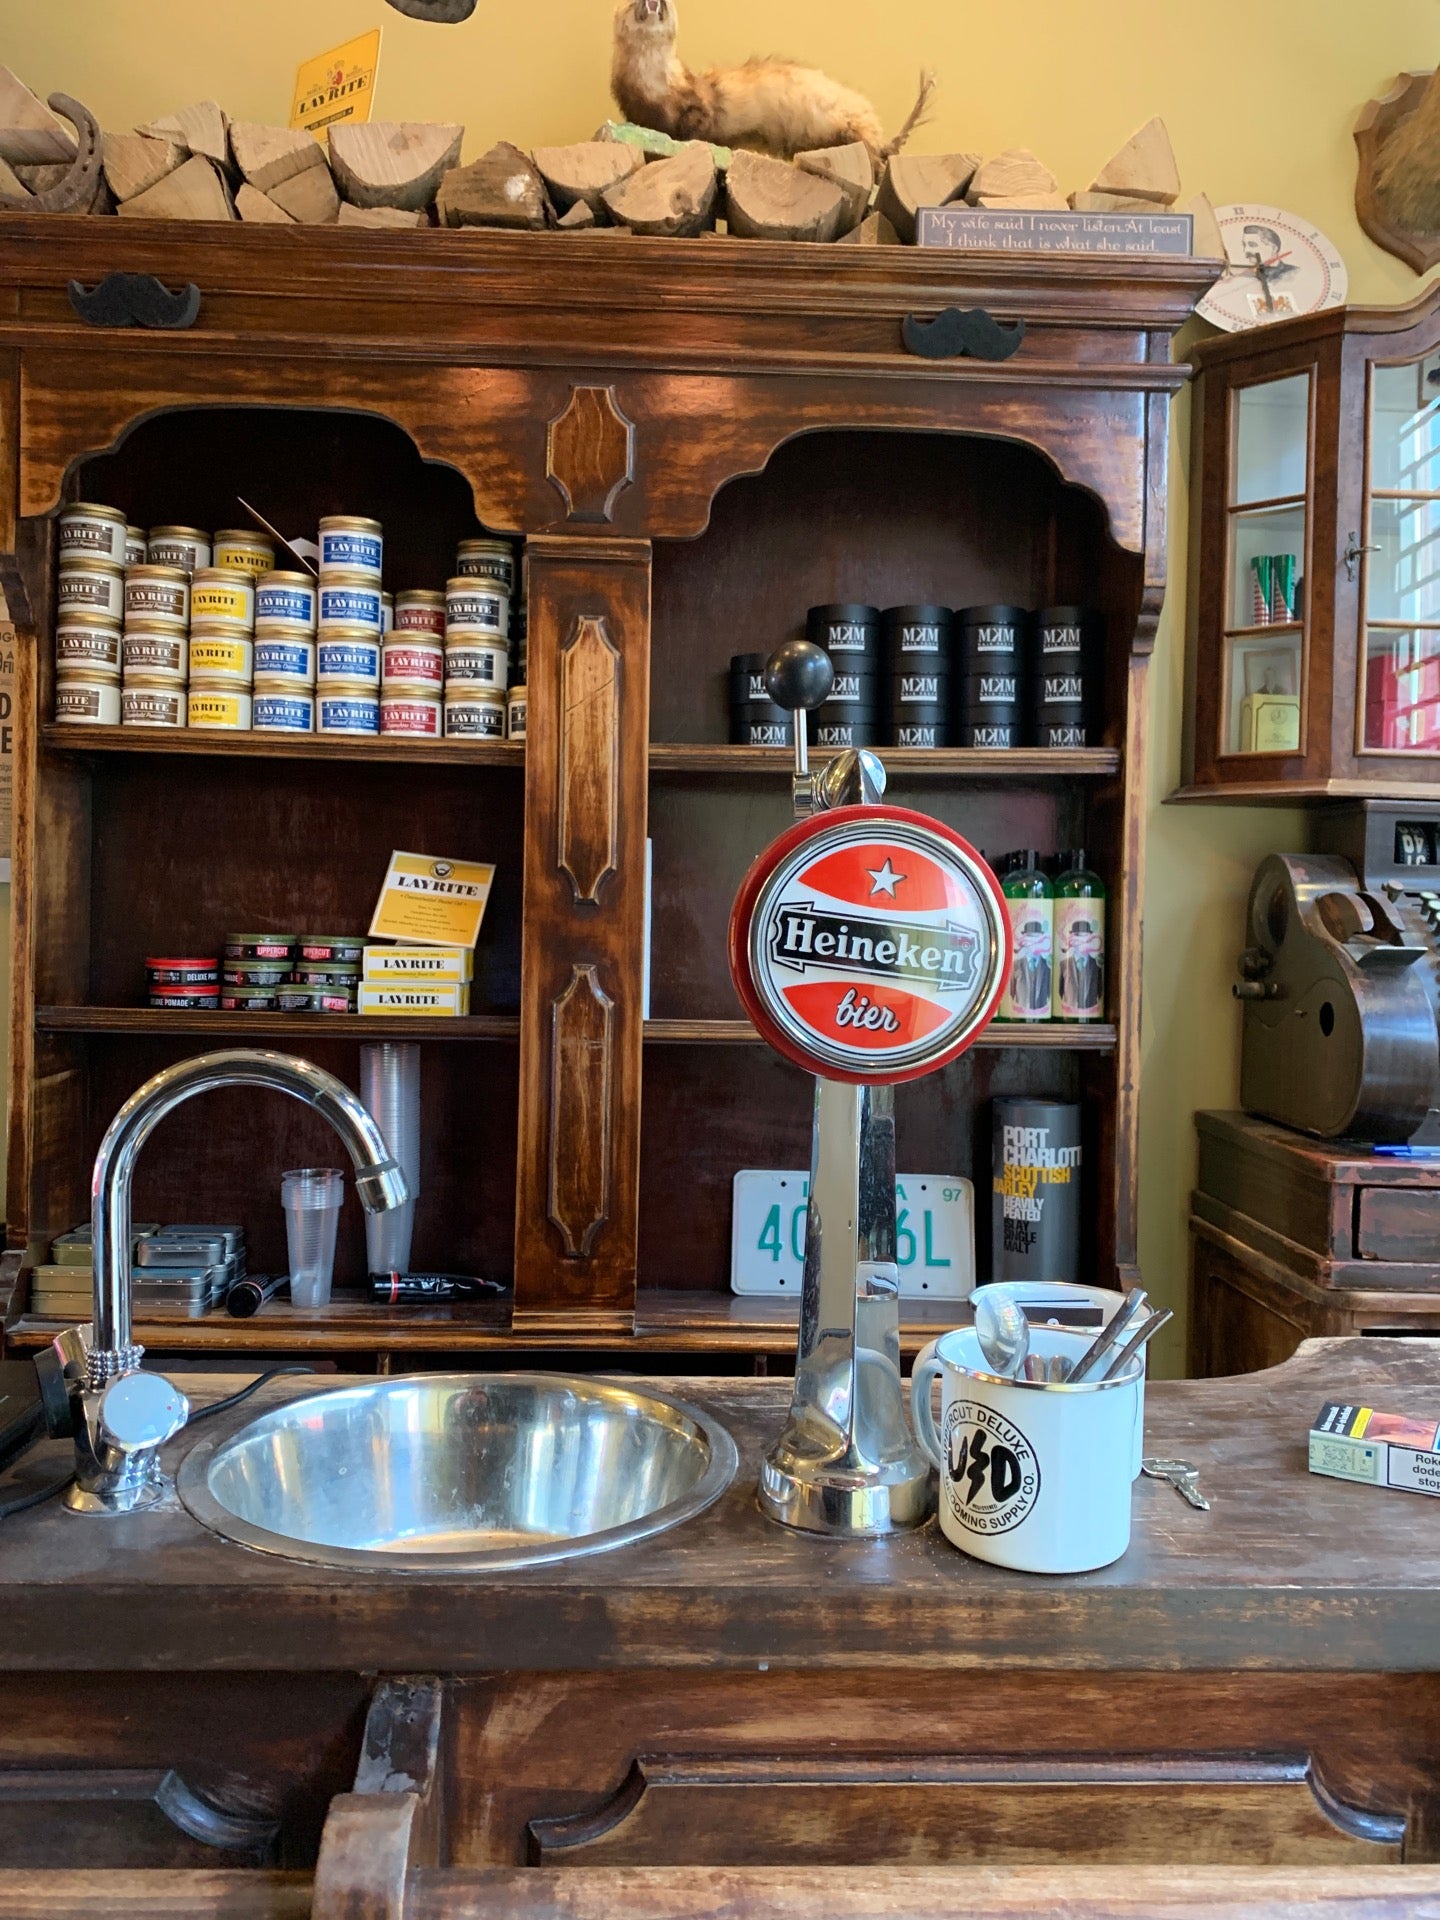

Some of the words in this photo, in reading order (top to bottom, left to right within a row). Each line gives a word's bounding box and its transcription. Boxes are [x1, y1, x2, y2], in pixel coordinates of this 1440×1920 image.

[931, 214, 956, 231] My
[961, 215, 990, 229] wife
[994, 218, 1024, 230] said
[1030, 216, 1035, 231] I
[1039, 220, 1079, 231] never
[1125, 219, 1143, 233] At
[1149, 219, 1182, 234] least
[958, 233, 997, 248] think
[1002, 234, 1033, 249] that
[1039, 236, 1051, 249] is
[1055, 236, 1091, 250] what
[1096, 237, 1121, 251] she
[330, 543, 377, 557] LAYRITE
[462, 565, 507, 577] LAYRITE
[129, 591, 177, 604] LAYRITE
[193, 595, 238, 606] LAYRITE
[258, 598, 304, 609] LAYRITE
[328, 599, 375, 612] LAYRITE
[448, 604, 492, 615] LAYRITE
[62, 638, 111, 652] LAYRITE
[126, 646, 172, 658] LAYRITE
[191, 648, 235, 659] LAYRITE
[256, 652, 300, 663] LAYRITE
[324, 653, 371, 665] LAYRITE
[390, 657, 437, 669] LAYRITE
[124, 701, 170, 712] LAYRITE
[257, 706, 304, 718] LAYRITE
[329, 708, 376, 720] LAYRITE
[384, 711, 430, 722] LAYRITE
[451, 713, 498, 725] LAYRITE
[397, 876, 479, 897] LAYRITE
[257, 946, 288, 956] UPPERCUT
[784, 916, 965, 975] Heineken
[384, 959, 445, 970] LAYRITE
[186, 972, 208, 982] DELUXE
[164, 998, 189, 1007] POMADE
[378, 994, 440, 1005] LAYRITE
[836, 988, 899, 1033] bier
[1003, 1125, 1050, 1148] PORT
[1003, 1164, 1071, 1184] SCOTTISH
[942, 1188, 962, 1202] 97
[1003, 1195, 1045, 1210] HEAVILY
[1003, 1207, 1041, 1222] PEATED
[1003, 1218, 1030, 1232] ISLAY
[1003, 1229, 1037, 1243] SINGLE
[1003, 1240, 1030, 1254] MALT
[976, 1409, 1030, 1462] DELUXE
[1415, 1453, 1440, 1467] Rok
[989, 1495, 1029, 1530] SUPPLY
[1022, 1472, 1035, 1496] CO.
